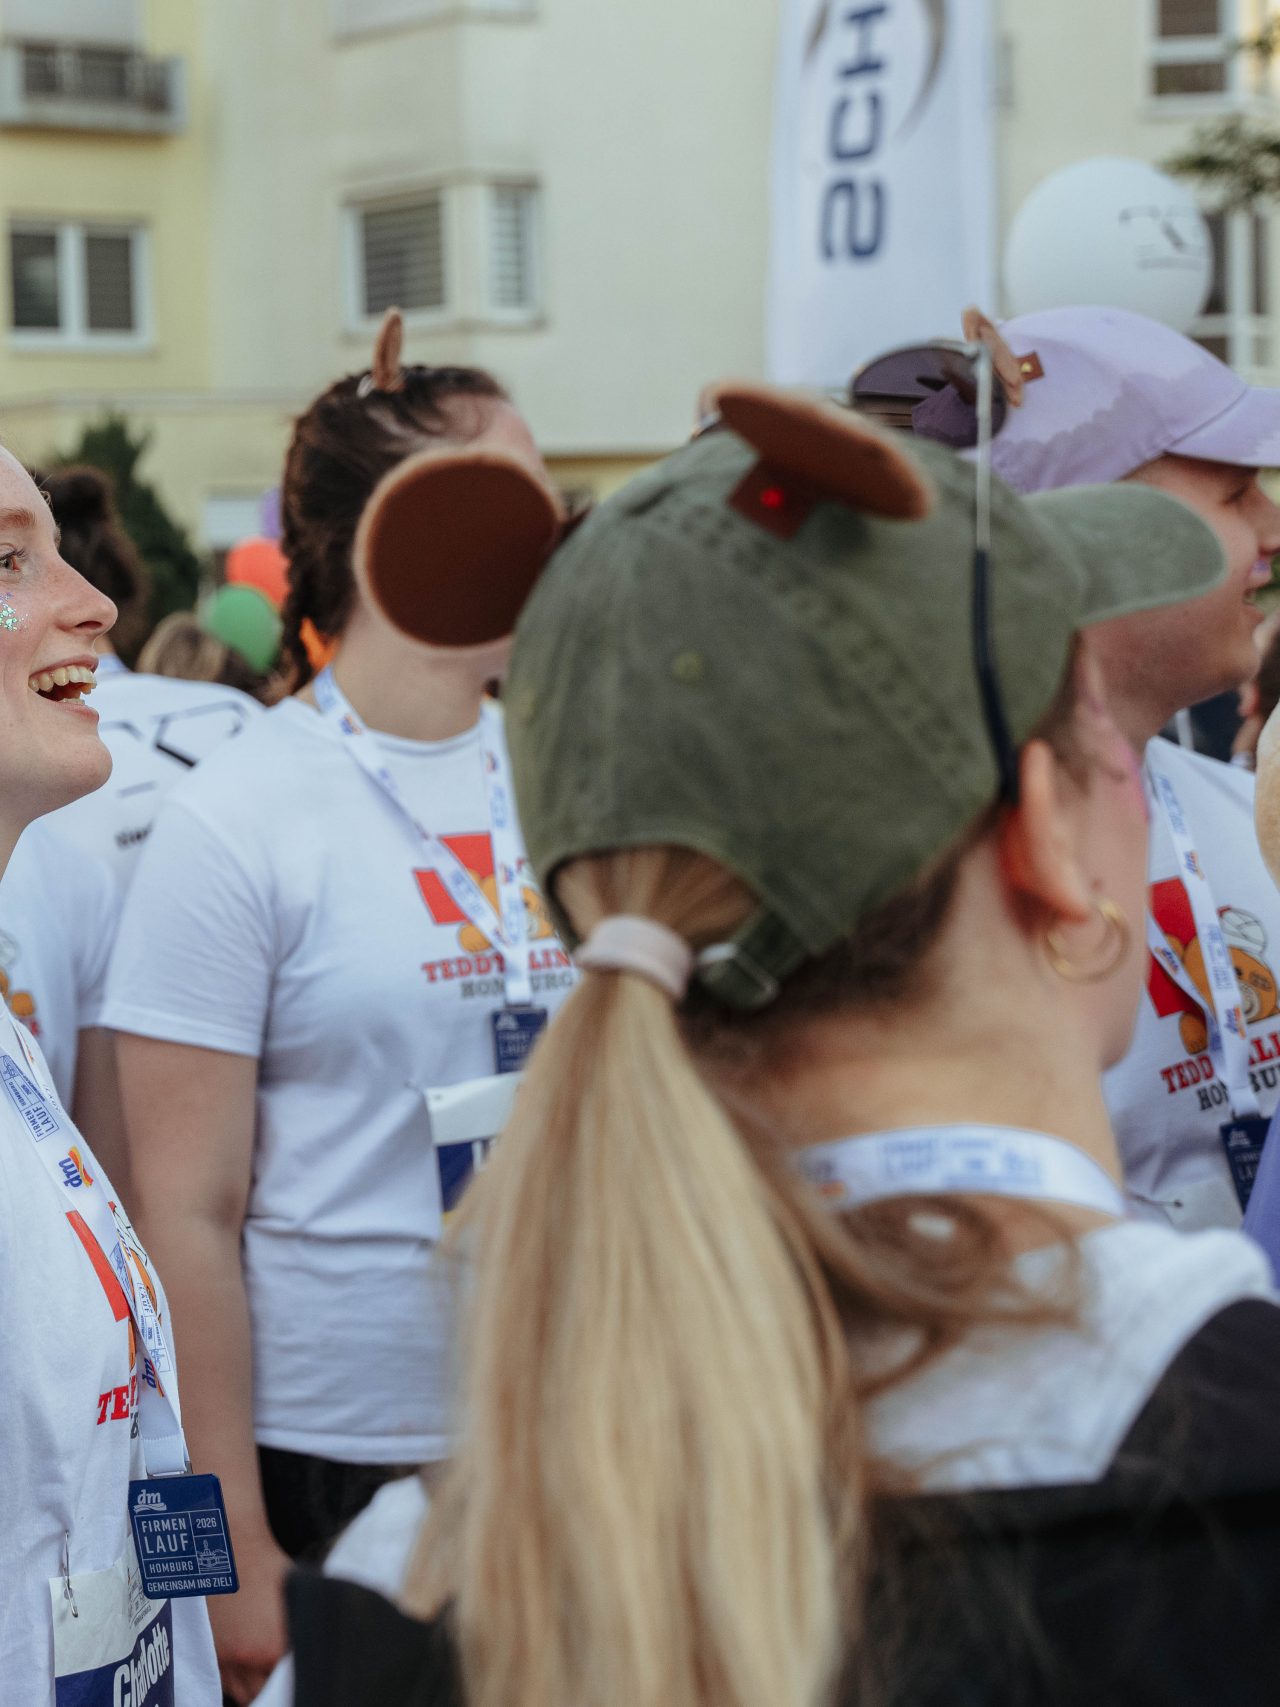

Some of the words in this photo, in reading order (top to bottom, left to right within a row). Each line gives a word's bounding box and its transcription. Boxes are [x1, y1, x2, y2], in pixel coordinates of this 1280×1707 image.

[24, 1110, 44, 1137] FIRMEN
[32, 1106, 55, 1132] LAUF
[58, 1157, 83, 1188] dm
[137, 1489, 162, 1505] dm
[141, 1518, 187, 1533] FIRMEN
[196, 1517, 217, 1529] 2026
[144, 1533, 189, 1554] LAUF
[149, 1561, 194, 1574] HOMBURG
[147, 1580, 196, 1592] GEMEINSAM
[197, 1578, 211, 1589] INS
[212, 1576, 233, 1588] ZIEL!
